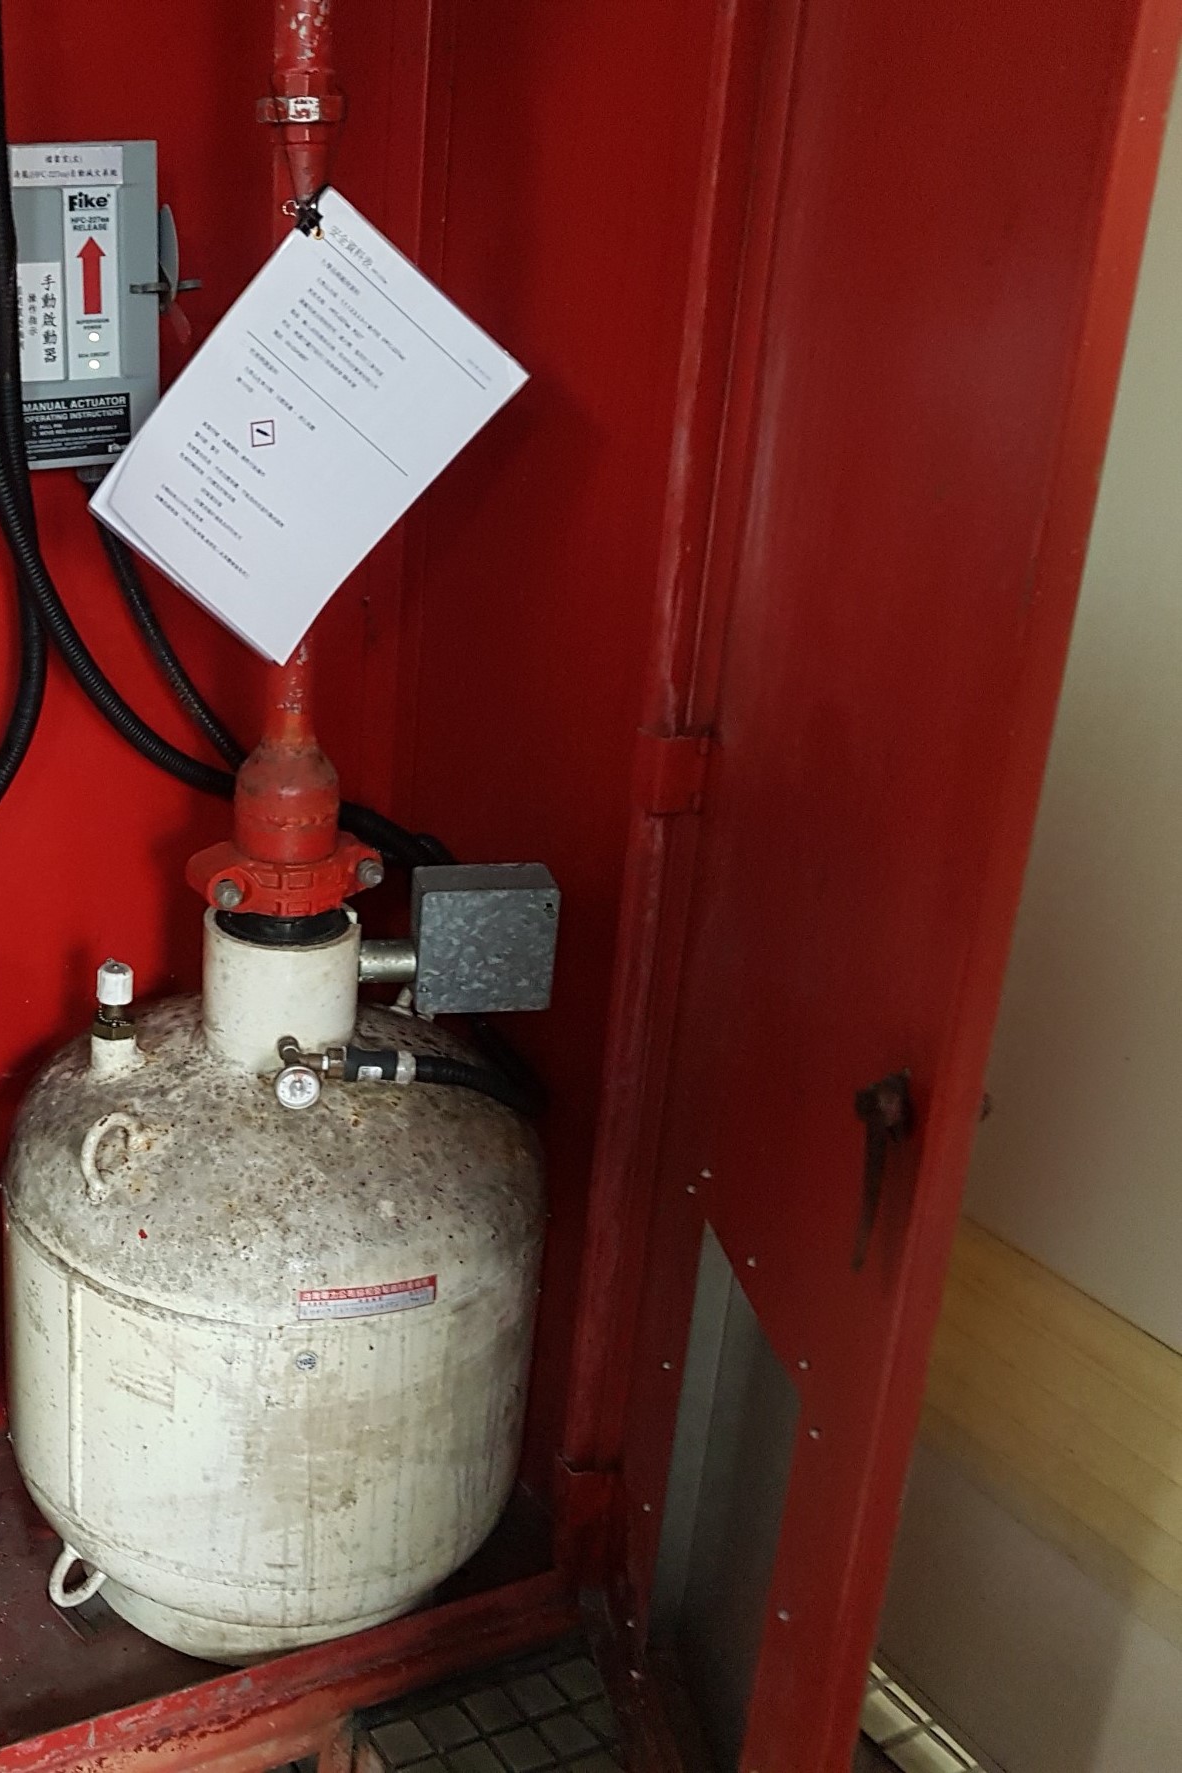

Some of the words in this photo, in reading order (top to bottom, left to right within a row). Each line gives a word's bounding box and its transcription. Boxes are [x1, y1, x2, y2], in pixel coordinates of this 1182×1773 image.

[68, 191, 109, 212] Fike
[71, 216, 110, 224] HFC-227ea
[73, 223, 108, 232] RELEASE
[22, 401, 69, 412] MANUAL
[70, 396, 127, 409] ACTUATOR
[24, 413, 68, 423] OPERATING
[69, 408, 125, 420] INSTRUCTIONS
